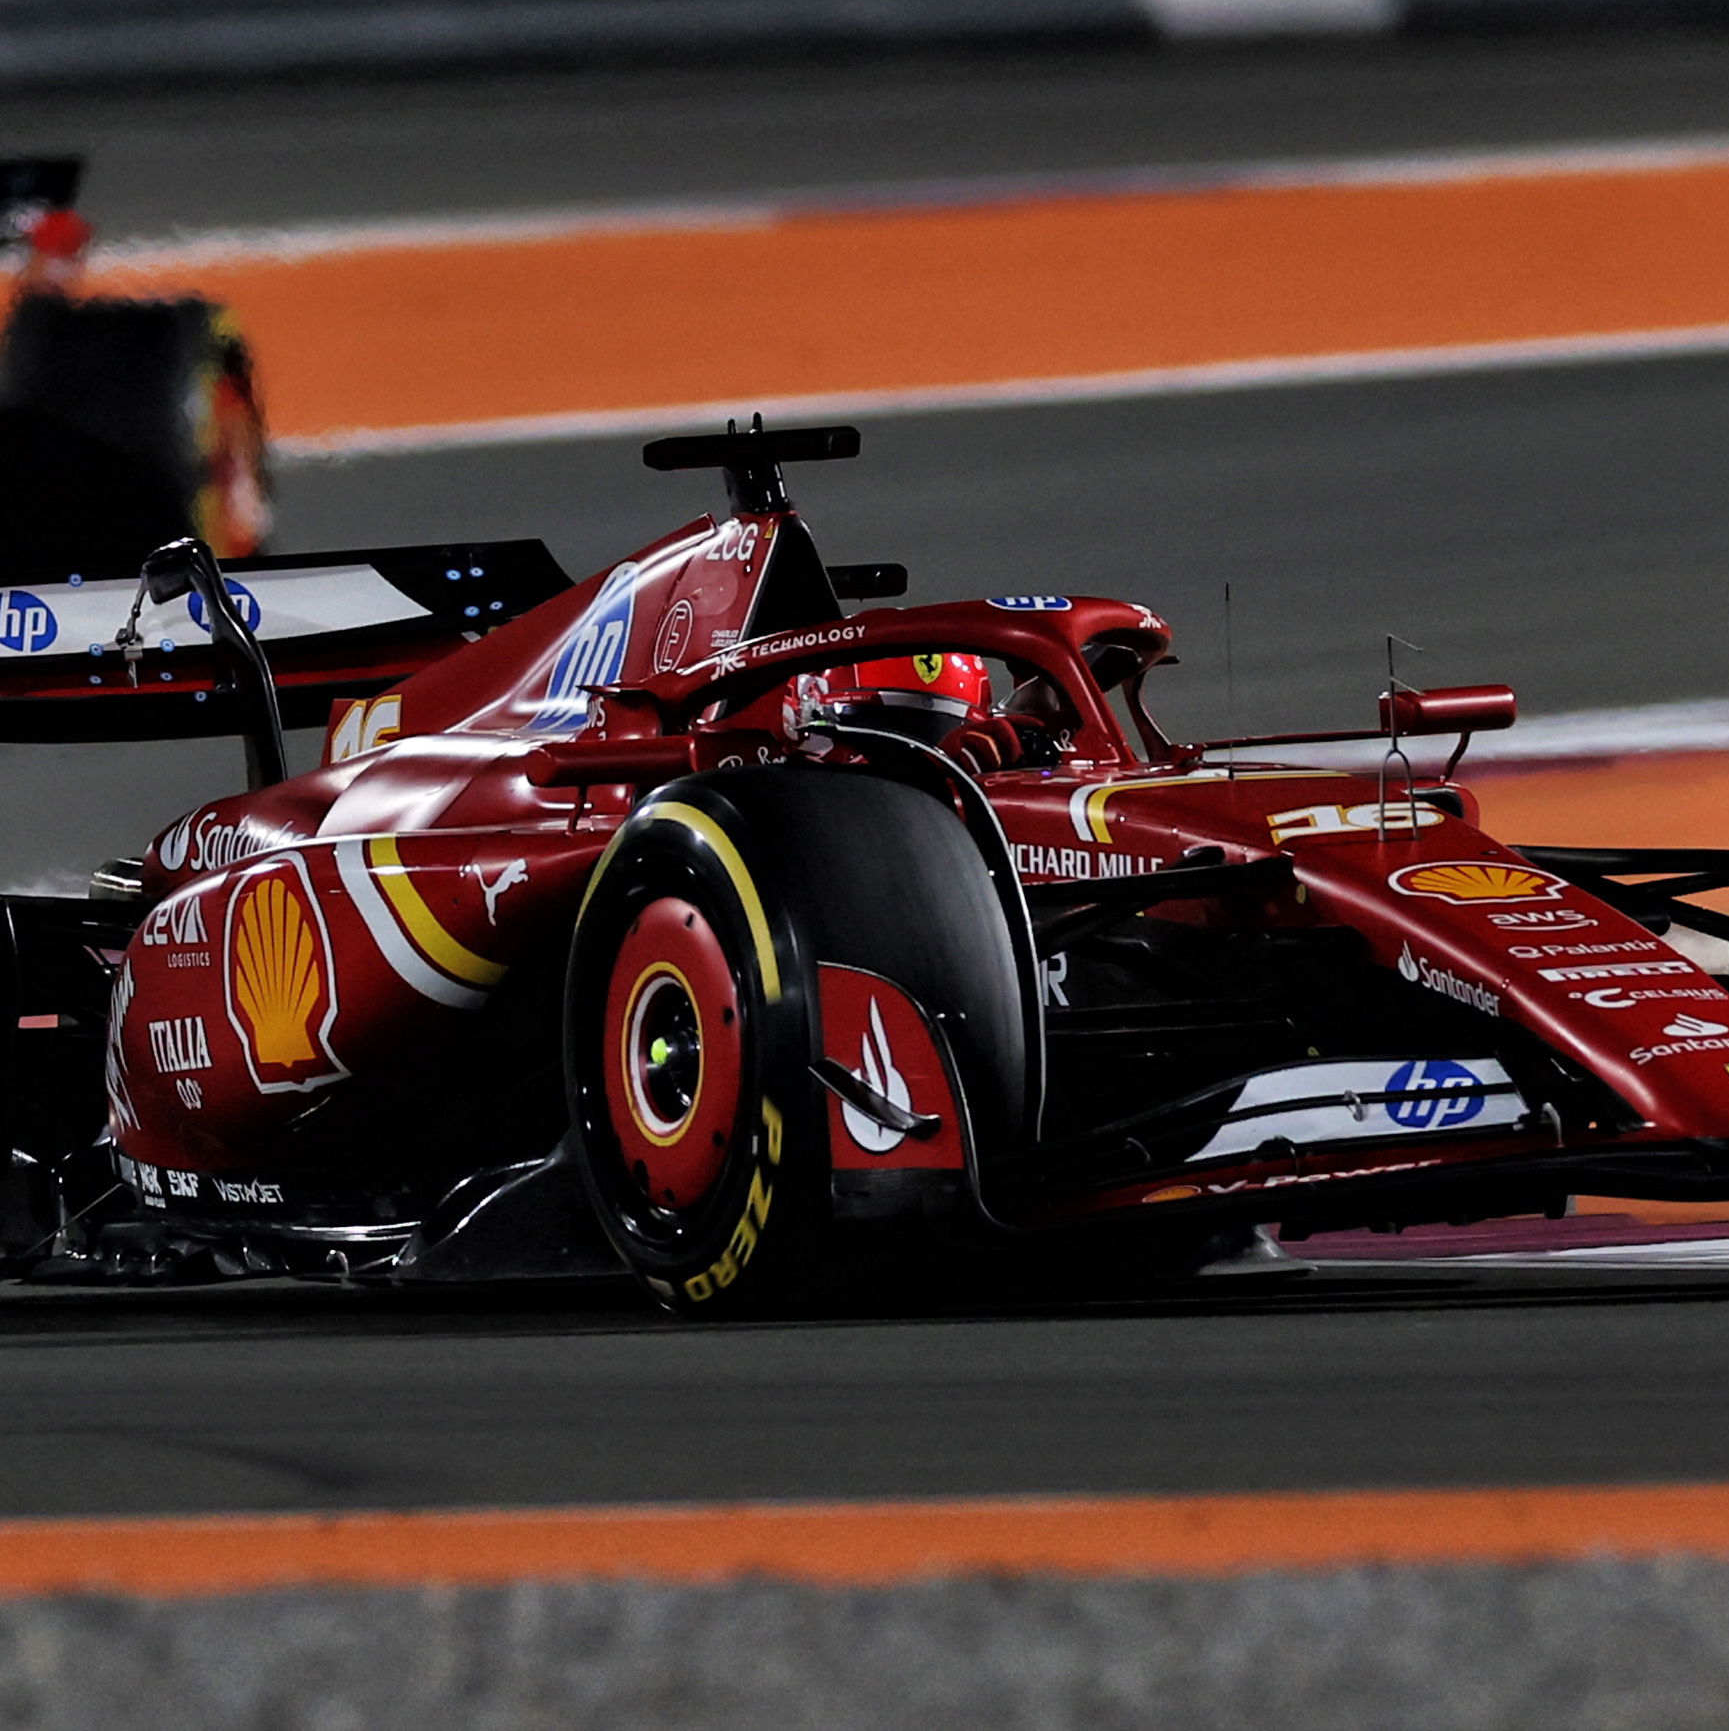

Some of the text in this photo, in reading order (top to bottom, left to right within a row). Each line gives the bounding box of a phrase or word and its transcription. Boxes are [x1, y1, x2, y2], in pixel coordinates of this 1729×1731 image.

[751, 625, 866, 658] TECHNOLOGY
[1266, 801, 1445, 846] 16
[1486, 909, 1586, 925] aws
[167, 952, 211, 968] LOGISTICS
[1540, 940, 1658, 957] Palantir
[1418, 956, 1501, 1018] Santander
[1536, 960, 1695, 983] PIRELLI
[148, 1016, 213, 1074] ITALIA
[1397, 1060, 1475, 1131] hp
[166, 1169, 199, 1198] SKF
